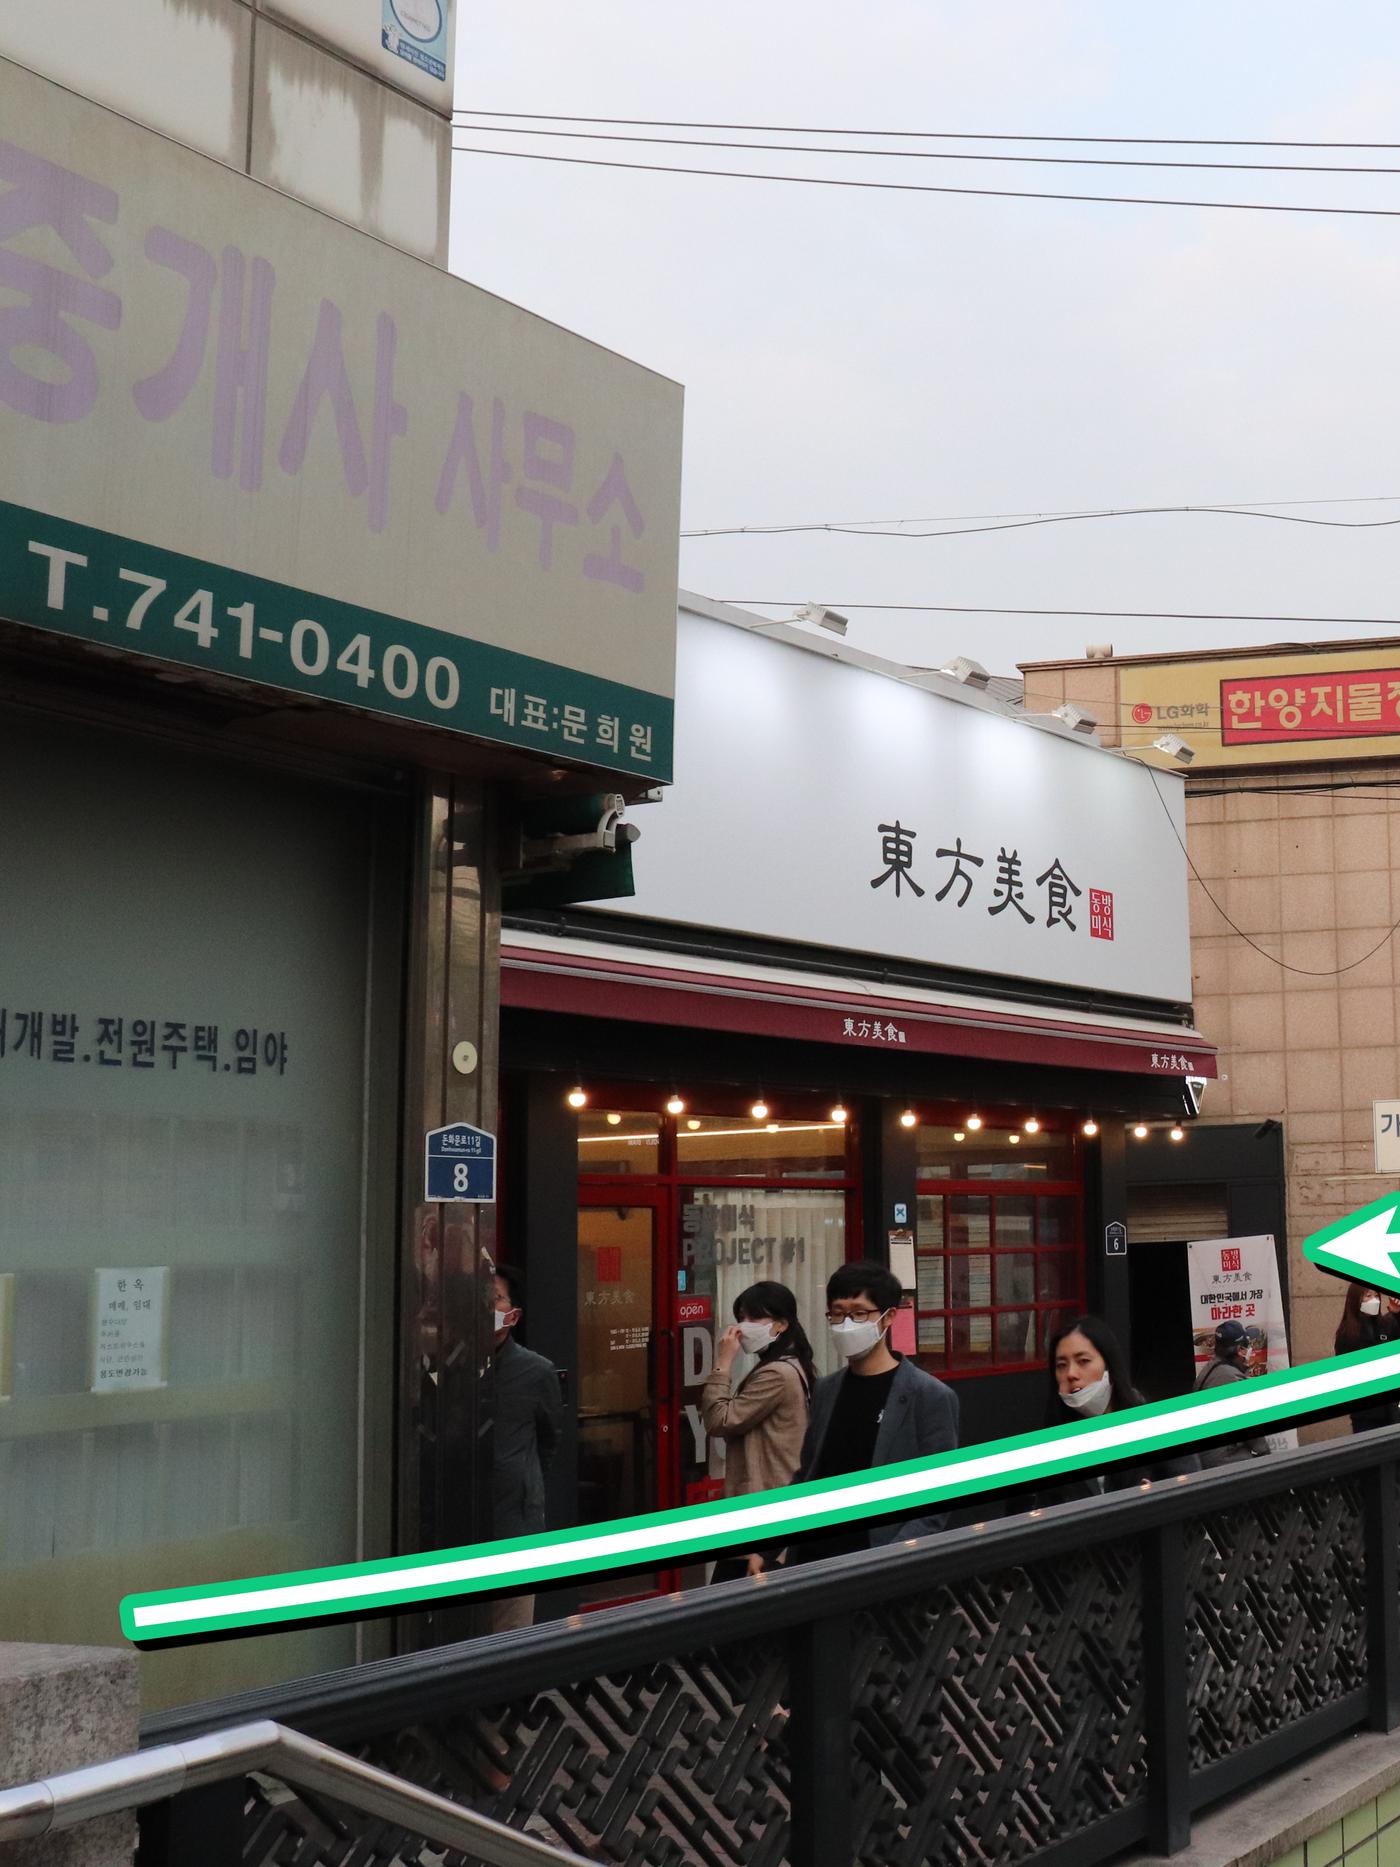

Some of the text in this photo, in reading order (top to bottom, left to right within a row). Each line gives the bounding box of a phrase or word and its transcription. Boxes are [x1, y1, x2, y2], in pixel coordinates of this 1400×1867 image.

[434, 391, 645, 593] 사무소
[27, 540, 460, 709] T.741-0400
[870, 820, 1083, 932] 東方美食
[843, 1017, 899, 1042] 東方美食
[1151, 1053, 1189, 1071] 東方美食
[453, 1163, 469, 1192] 8
[683, 1237, 777, 1267] PROJECT
[1113, 1238, 1119, 1250] 6
[680, 1302, 704, 1318] open
